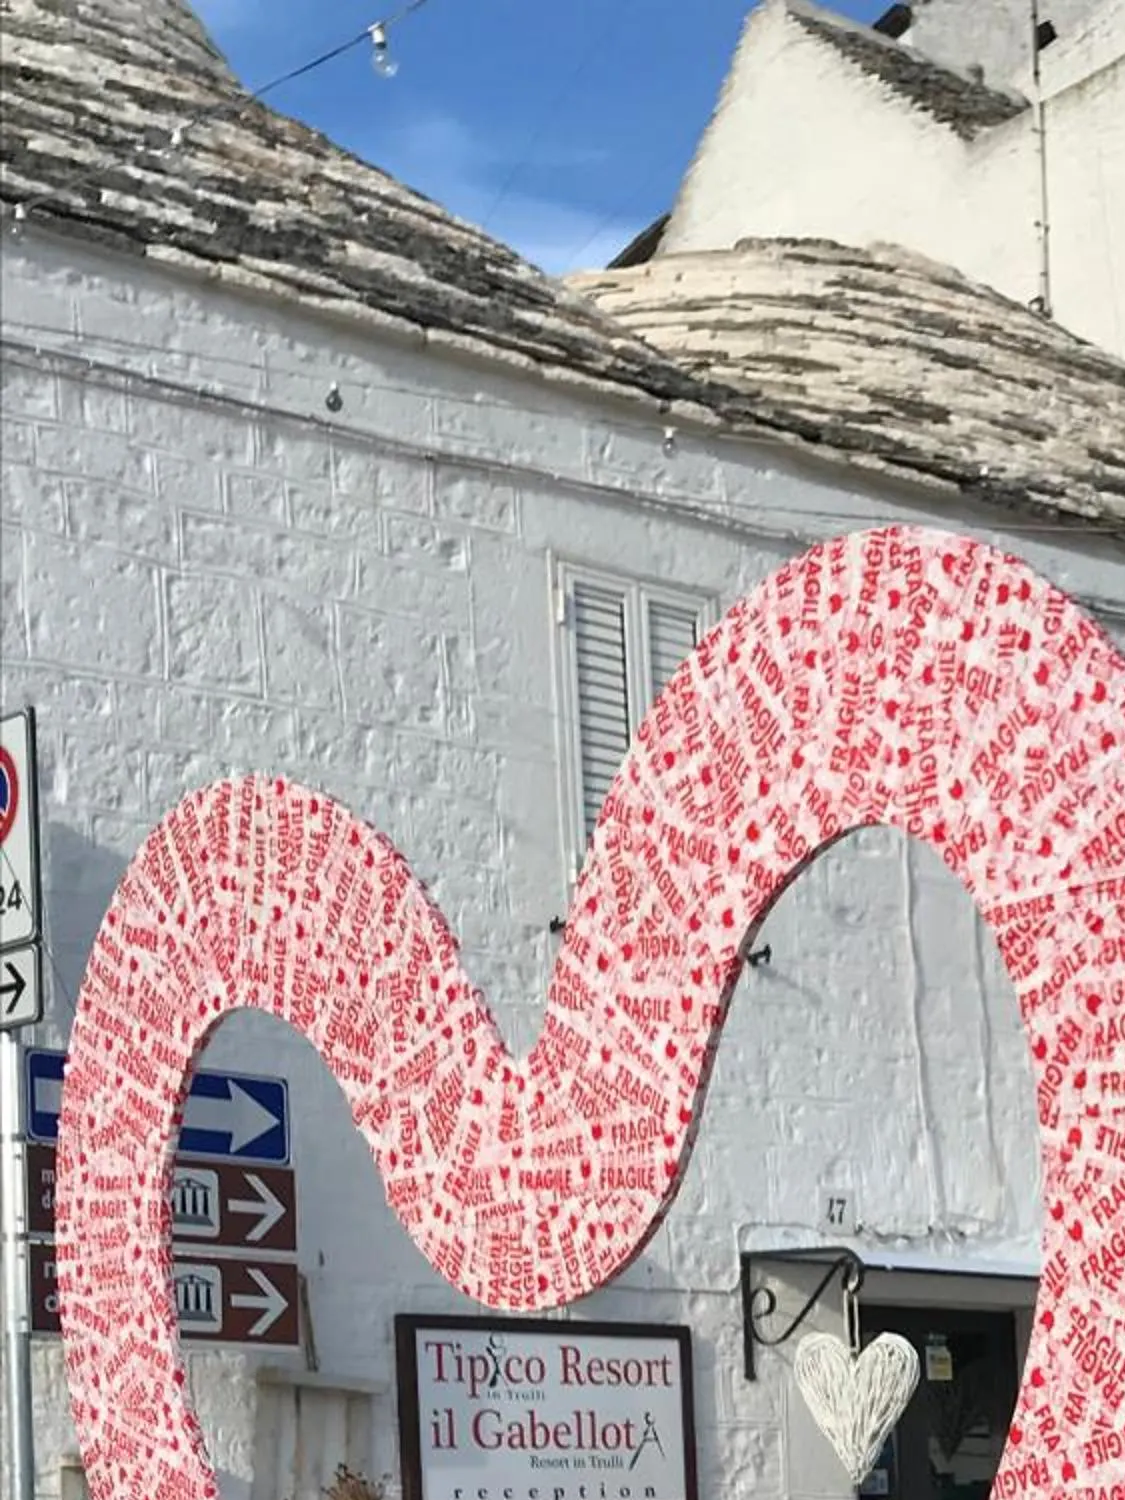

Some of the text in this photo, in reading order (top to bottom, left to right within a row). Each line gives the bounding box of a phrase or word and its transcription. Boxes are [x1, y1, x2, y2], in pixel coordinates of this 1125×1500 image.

[735, 670, 787, 752] FRAGILE
[916, 705, 939, 807] FRAGILE
[660, 823, 719, 866] FRAGILE
[1019, 941, 1088, 1016] FRAGILE
[616, 994, 671, 1022] FRAGILE
[602, 1167, 655, 1191] FRAGILE
[826, 1197, 847, 1225] 17
[559, 1344, 673, 1388] Resort
[430, 1408, 458, 1450] il
[529, 1455, 624, 1470] Resort in Trulli
